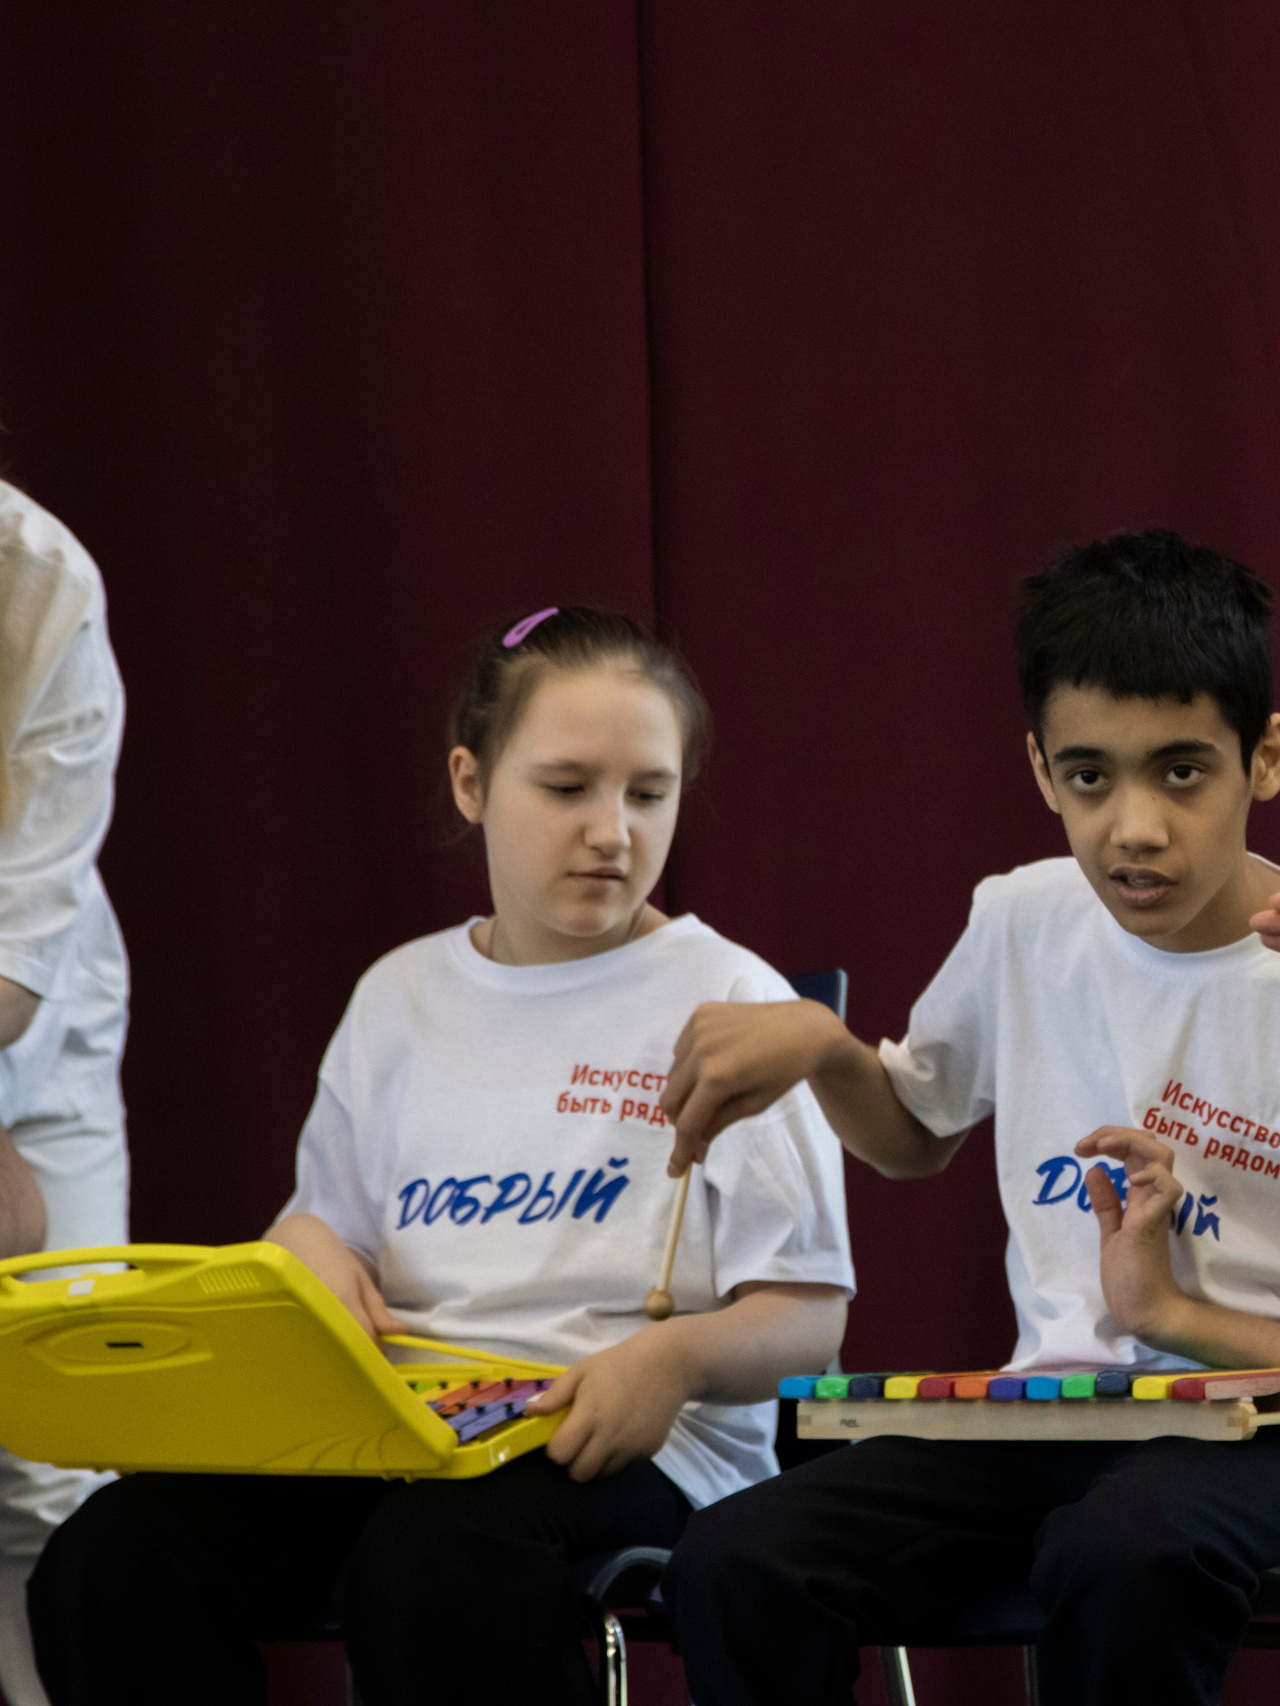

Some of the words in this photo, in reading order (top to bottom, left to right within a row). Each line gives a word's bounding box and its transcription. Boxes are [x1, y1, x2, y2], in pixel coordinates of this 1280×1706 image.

[570, 1064, 669, 1092] Искусст
[556, 1090, 612, 1114] быть
[619, 1098, 672, 1128] ряд
[1142, 1107, 1199, 1147] быть
[396, 1157, 630, 1231] ДОБРЫЙ
